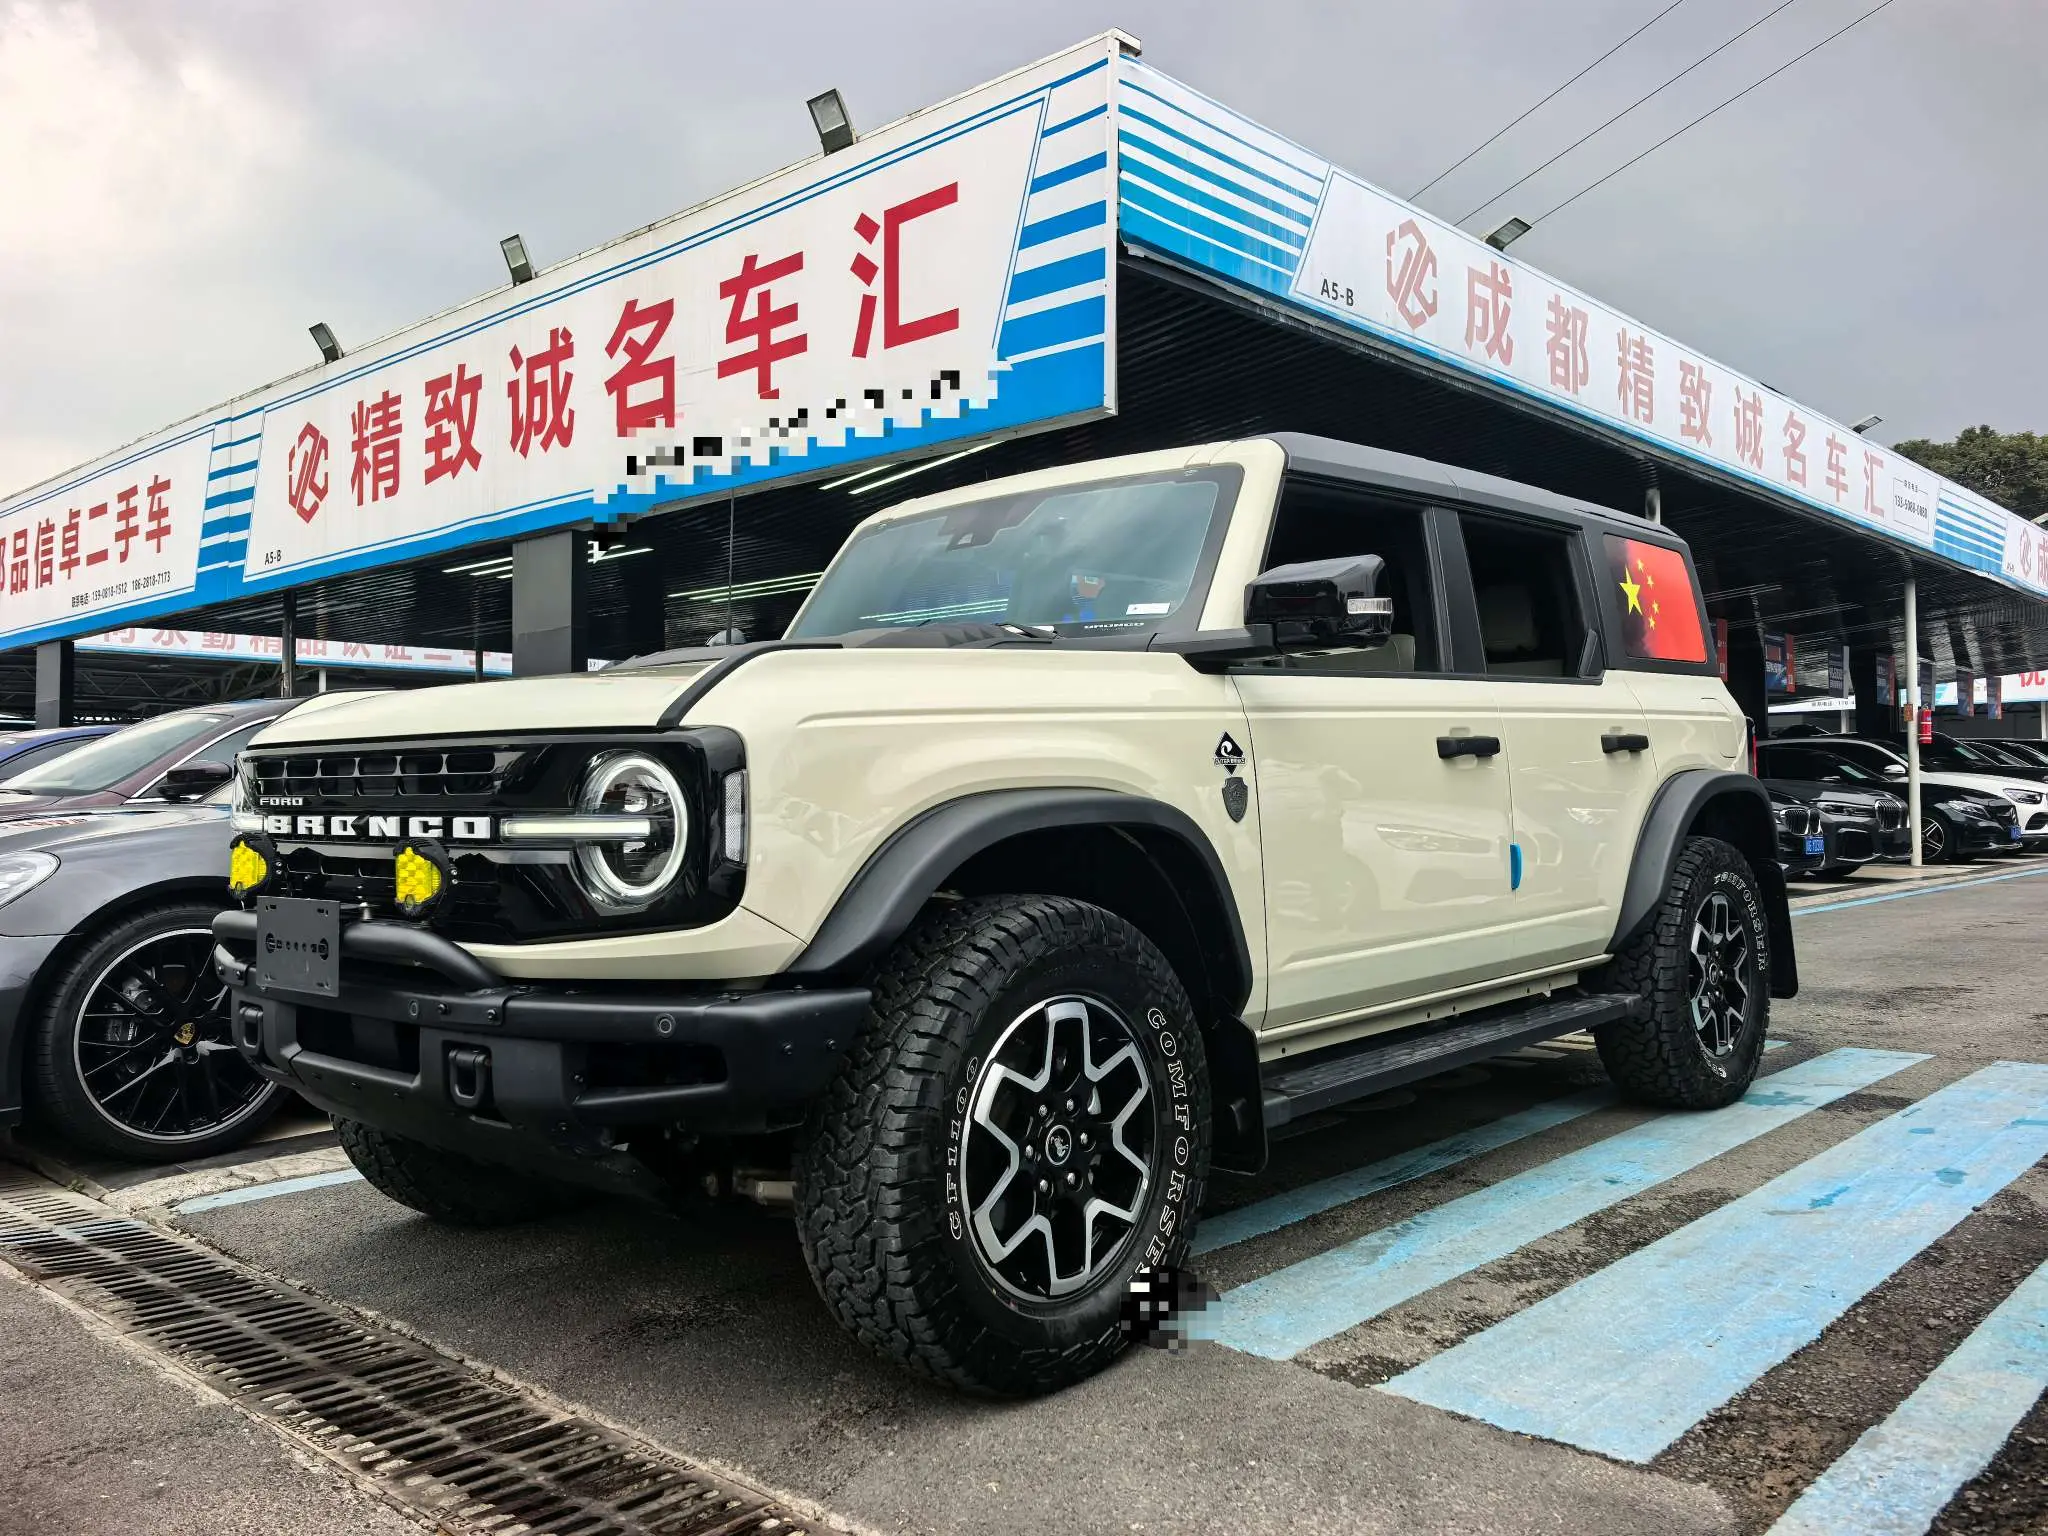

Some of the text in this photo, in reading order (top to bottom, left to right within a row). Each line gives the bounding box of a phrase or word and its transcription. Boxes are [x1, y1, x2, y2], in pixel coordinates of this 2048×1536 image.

[1320, 278, 1354, 307] A5-B
[352, 183, 959, 506] 精致诚名车汇
[1467, 261, 1884, 516] 成都精致诚名车汇
[264, 549, 282, 566] A5-B
[259, 796, 304, 807] FORD
[266, 815, 491, 839] BRONCO
